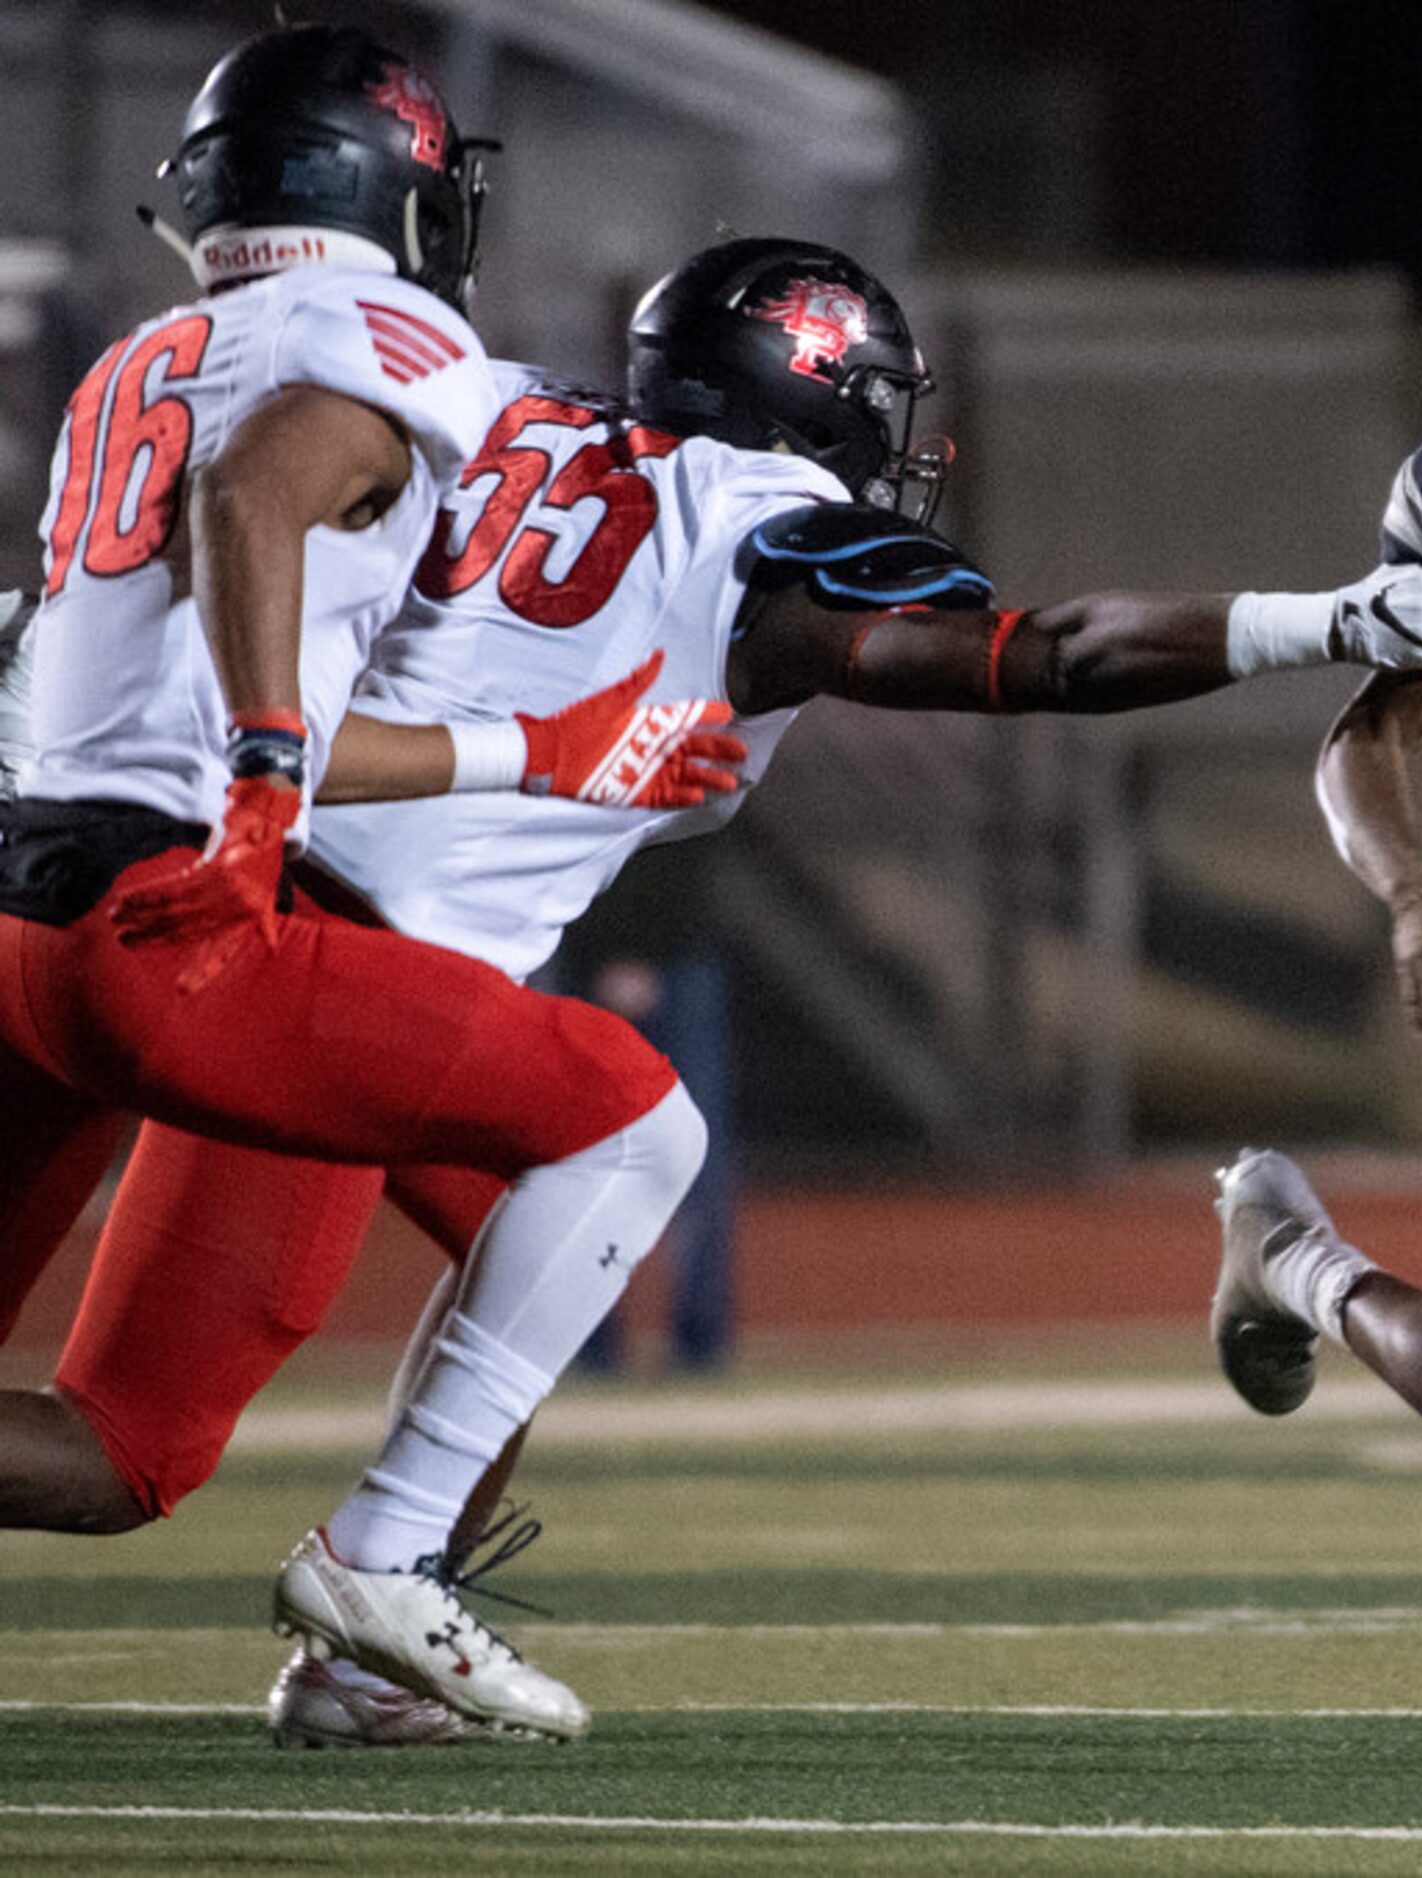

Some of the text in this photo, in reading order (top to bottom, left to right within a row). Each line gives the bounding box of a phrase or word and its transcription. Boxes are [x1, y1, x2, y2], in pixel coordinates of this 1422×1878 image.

[204, 237, 326, 268] Riddell
[45, 314, 213, 598] 16
[410, 394, 682, 629] 55
